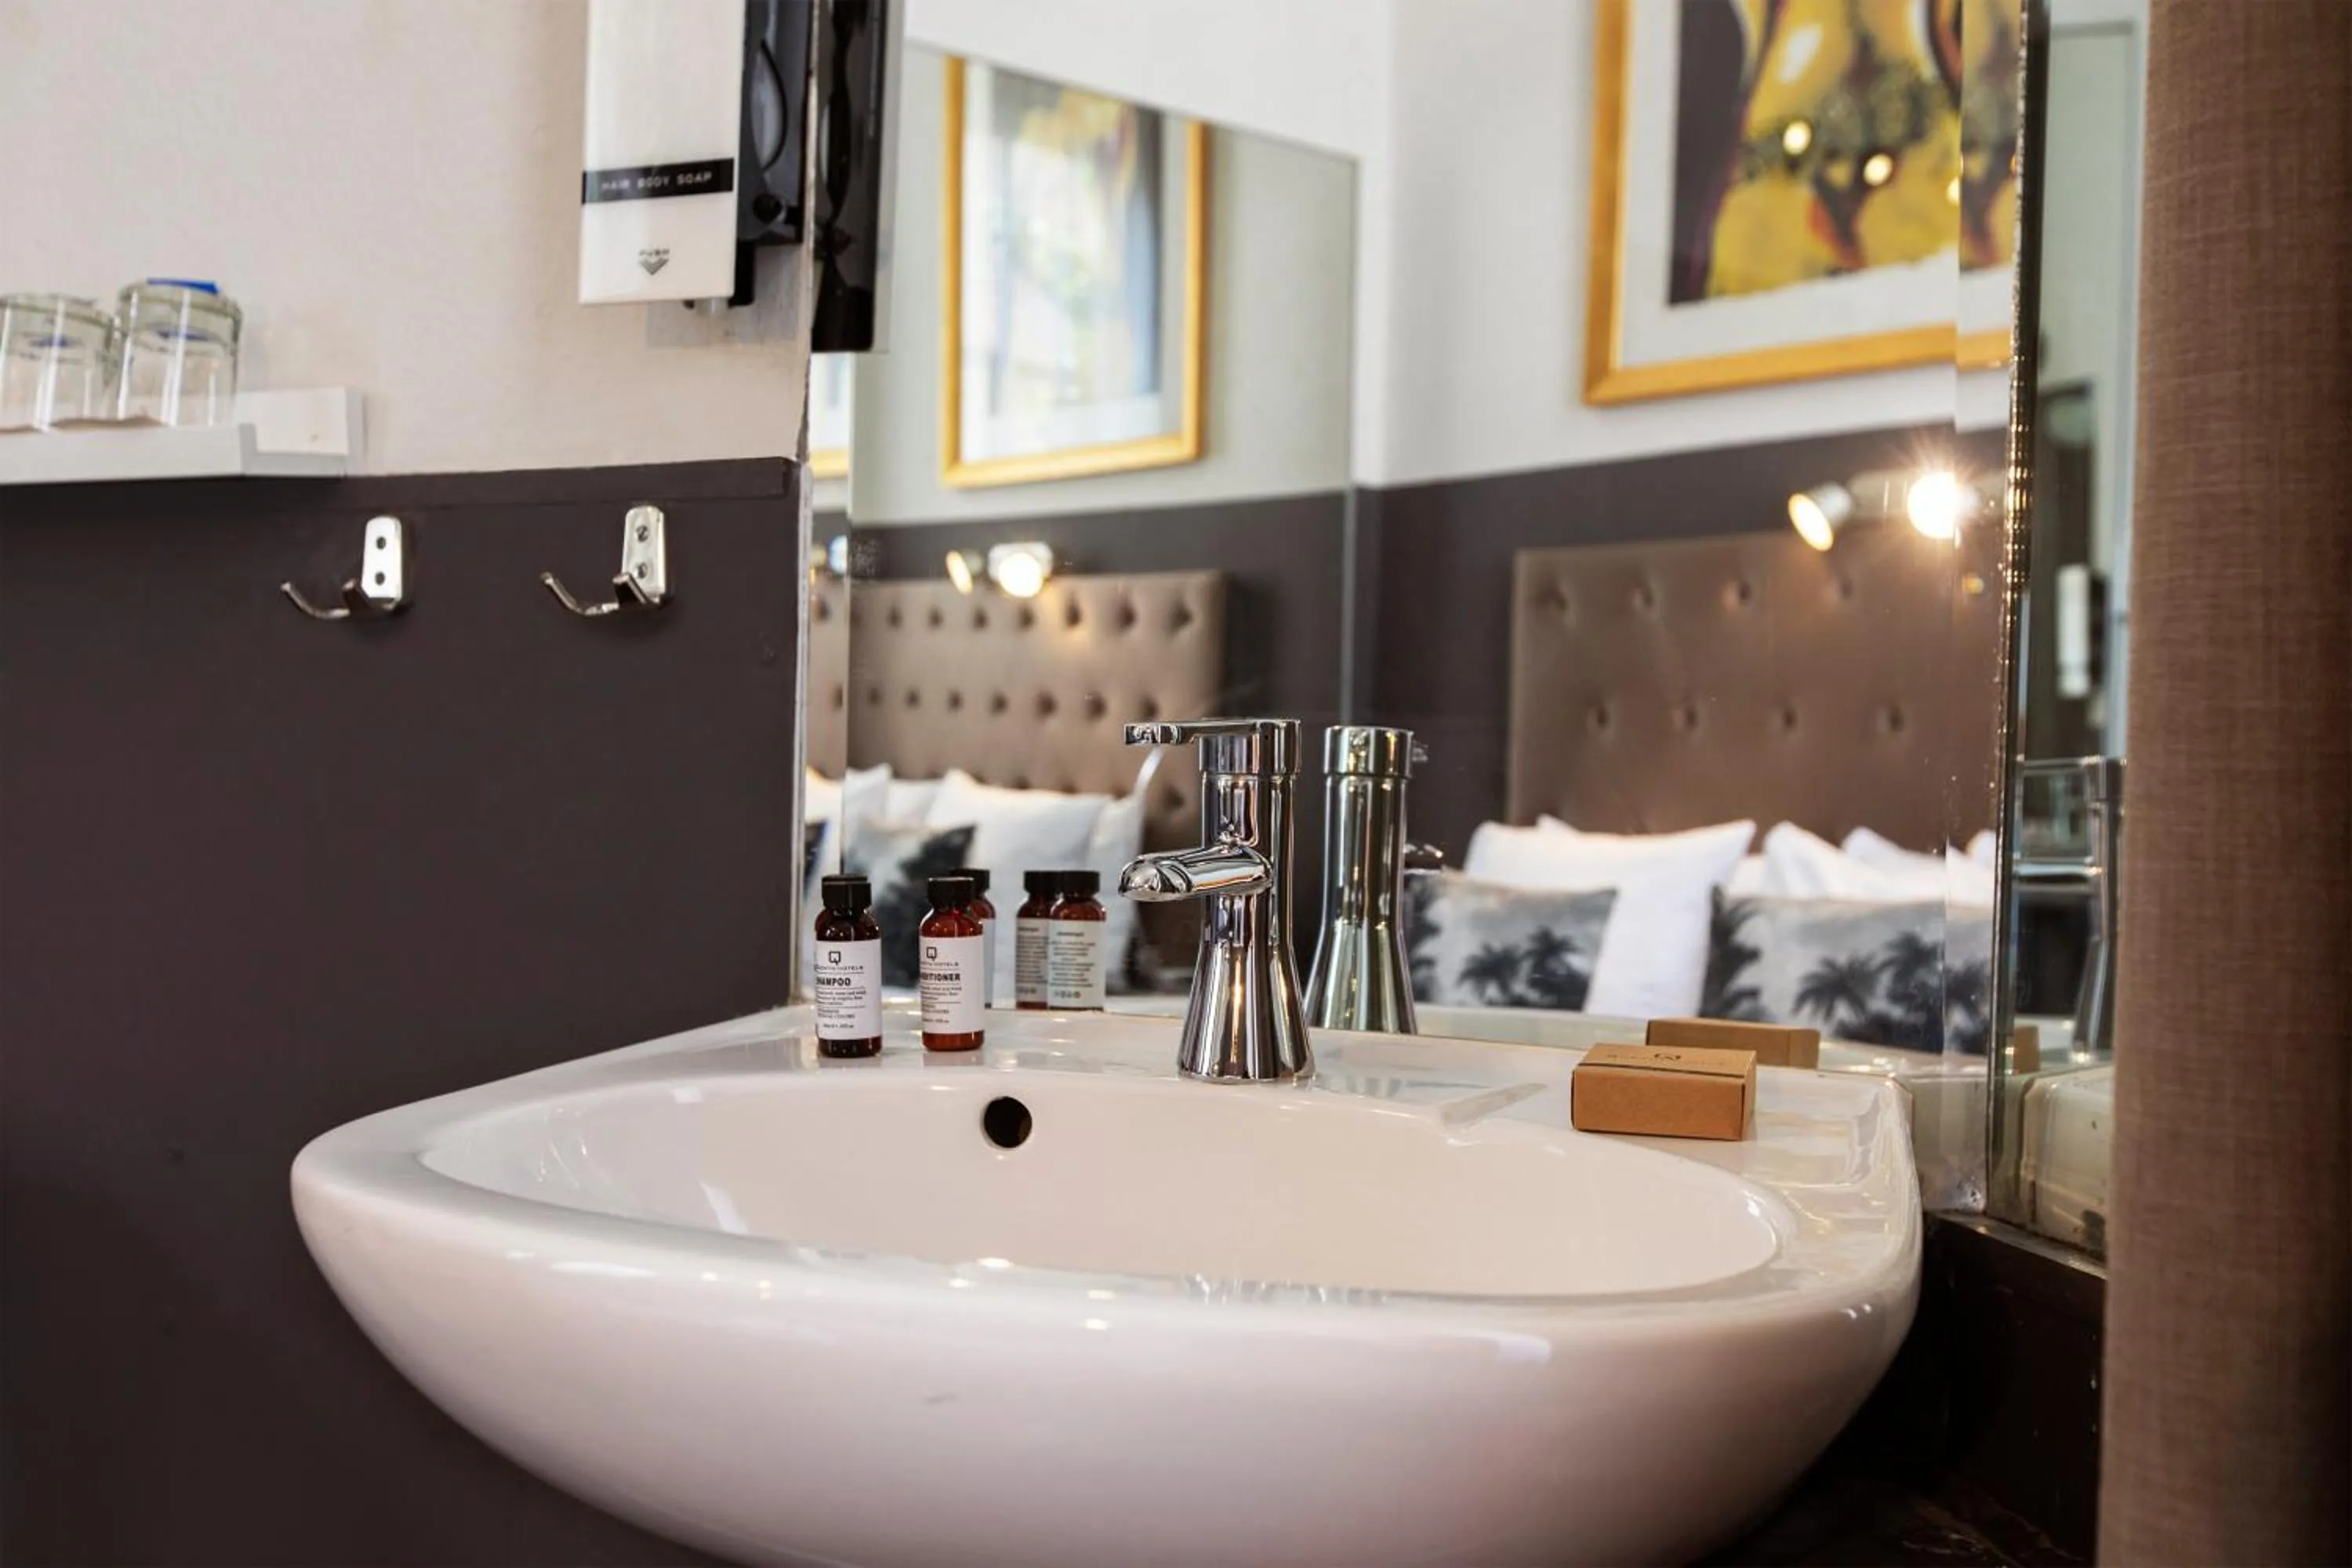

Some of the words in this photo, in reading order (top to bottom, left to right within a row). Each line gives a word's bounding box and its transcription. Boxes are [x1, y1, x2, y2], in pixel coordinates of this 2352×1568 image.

[601, 180, 630, 191] HAIR
[637, 176, 670, 189] BODY
[677, 171, 712, 185] SOAP
